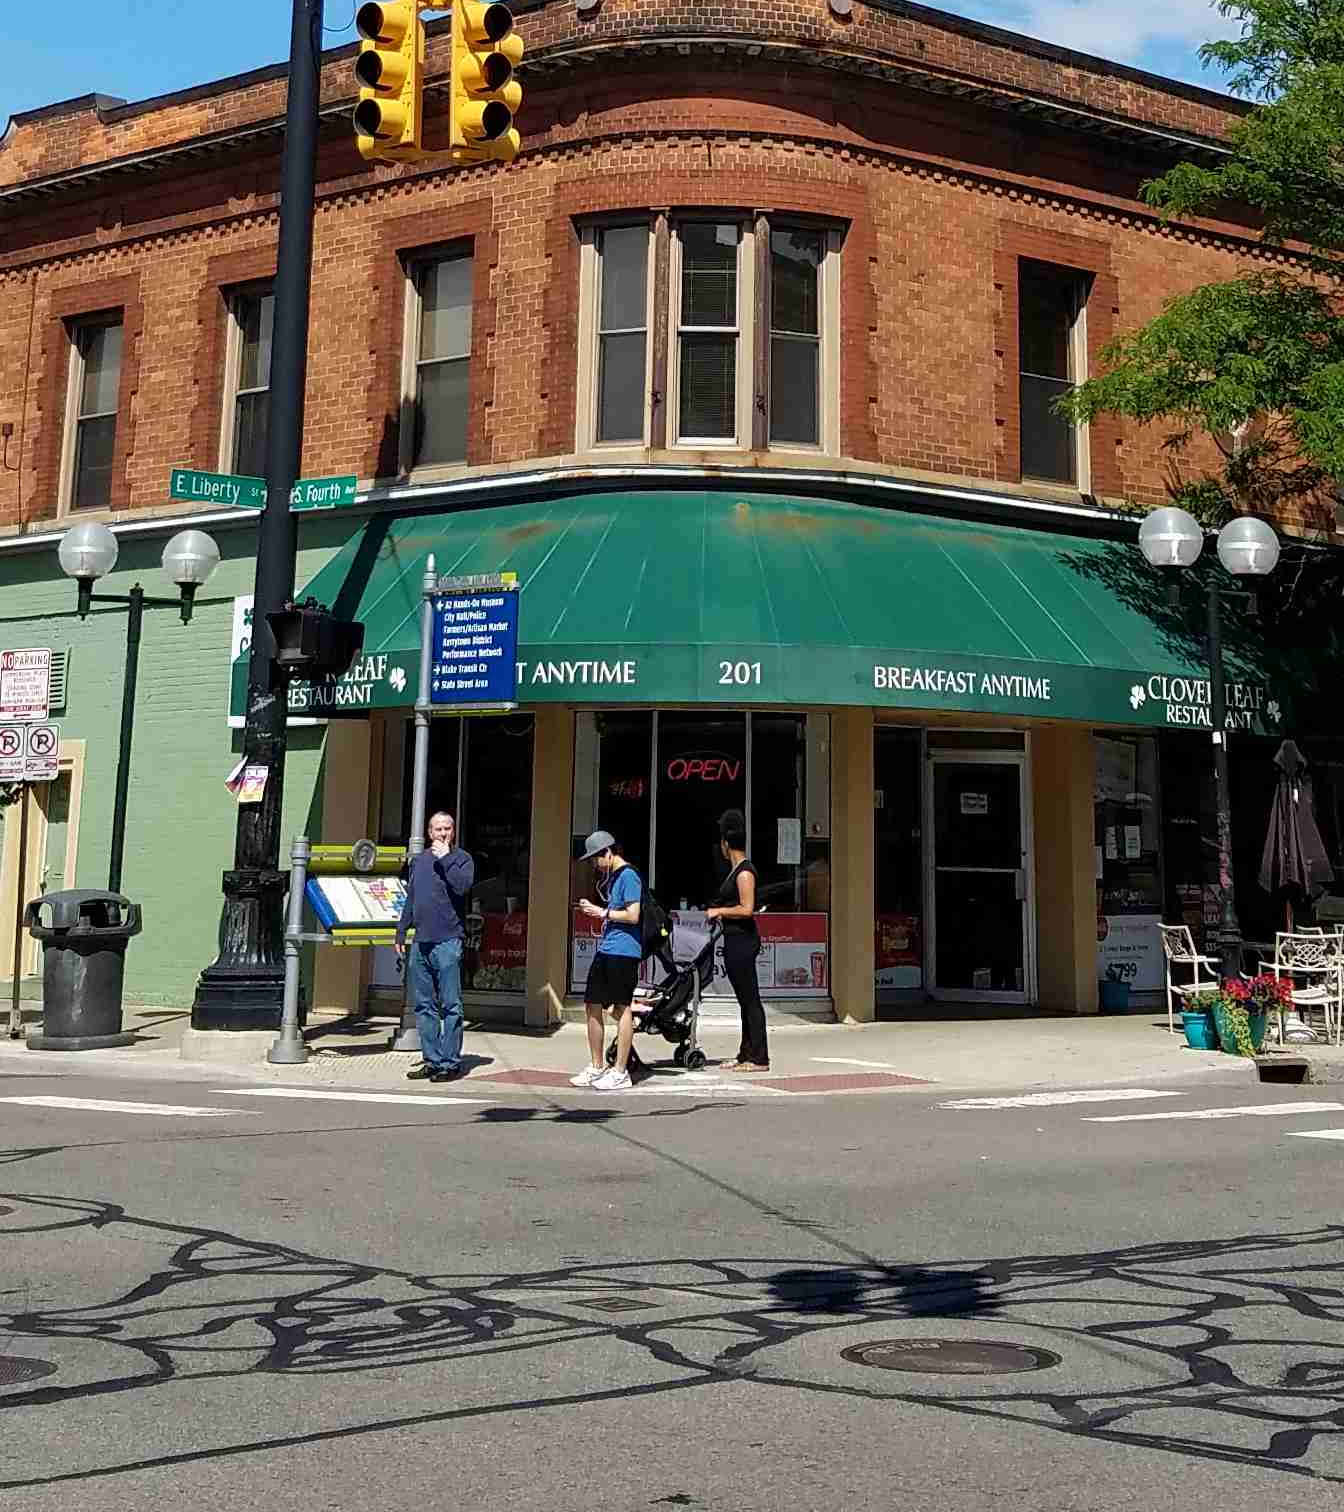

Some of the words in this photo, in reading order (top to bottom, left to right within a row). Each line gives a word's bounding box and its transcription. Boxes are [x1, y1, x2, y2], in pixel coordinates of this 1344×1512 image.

[176, 474, 188, 494] E.
[191, 476, 240, 504] Liberty
[294, 487, 304, 503] S.
[306, 483, 341, 502] Fourth
[444, 613, 454, 623] City
[489, 622, 508, 632] Market
[2, 653, 14, 669] NO
[14, 653, 48, 667] PARKING
[442, 649, 477, 659] Performance
[479, 647, 503, 657] Network
[458, 663, 477, 673] Transit
[532, 661, 636, 684] ANYTIME
[719, 661, 762, 684] 201
[441, 680, 456, 689] State
[874, 665, 977, 694] BREAKFAST
[980, 673, 1051, 700] ANYTIME
[1148, 675, 1212, 705] CLOVE
[1224, 683, 1264, 709] LEAF
[1166, 704, 1253, 728] RESTAUANT
[667, 759, 741, 781] OPEN
